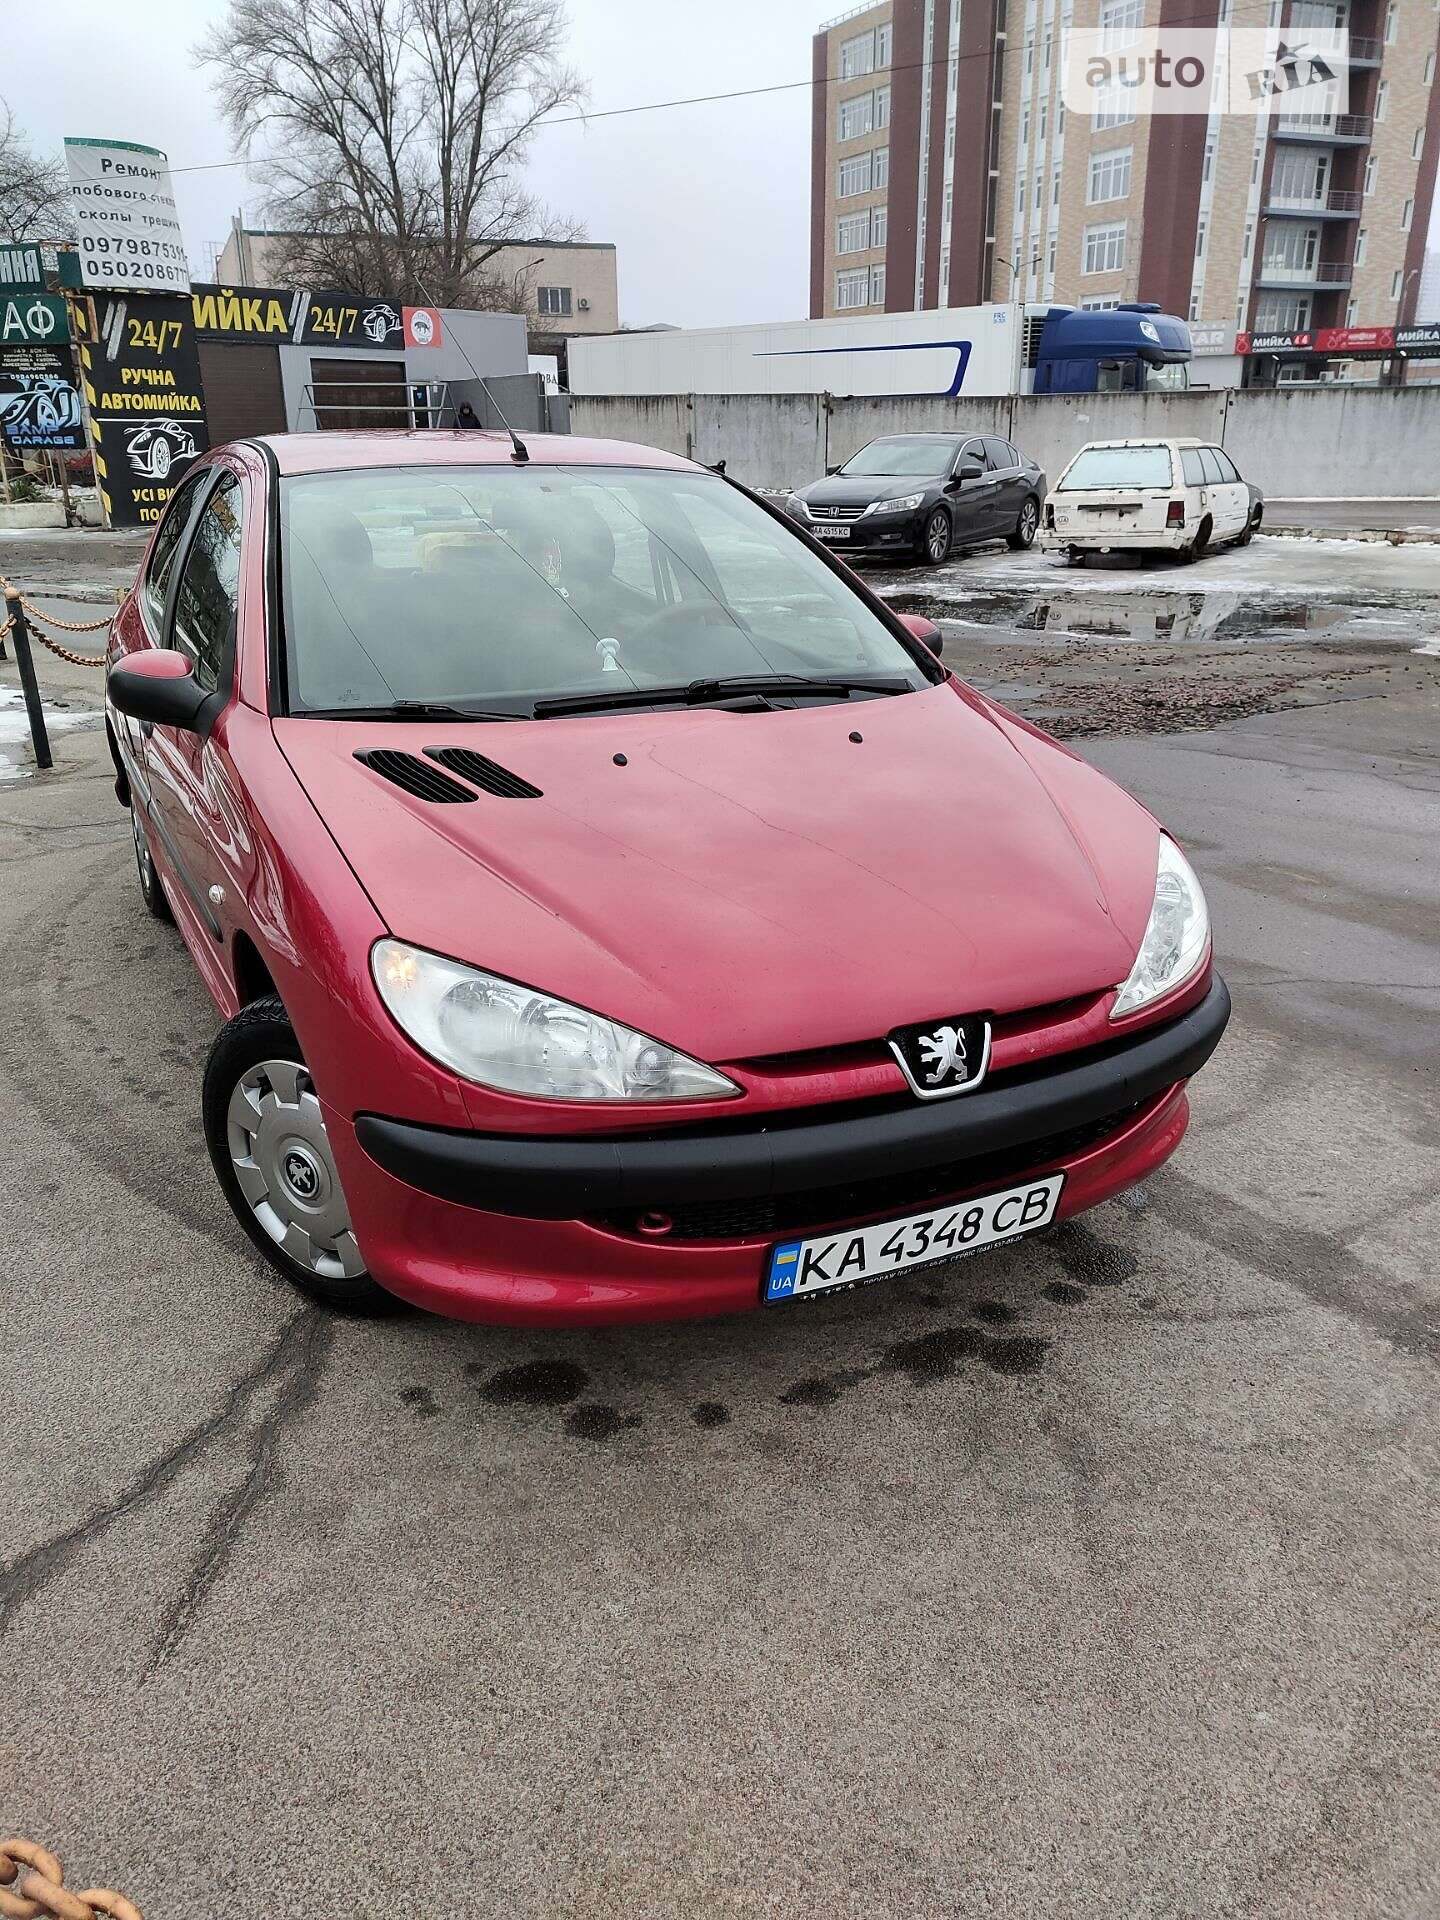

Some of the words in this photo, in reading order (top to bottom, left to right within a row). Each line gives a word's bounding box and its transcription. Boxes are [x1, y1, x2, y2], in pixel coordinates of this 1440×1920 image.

[79, 210, 132, 223] сколы
[2, 300, 55, 340] АФ
[311, 306, 358, 340] 24/7
[127, 318, 183, 355] 24/7
[1252, 335, 1293, 348] МИЙКА
[1396, 328, 1440, 342] МИЙКА
[121, 367, 176, 386] РУЧНА
[101, 391, 201, 411] АВТОМИЙКА
[131, 488, 155, 502] УСІ
[771, 1275, 793, 1291] UA
[799, 1236, 867, 1286] KA
[879, 1206, 984, 1263] 4348
[991, 1186, 1051, 1233] CB
